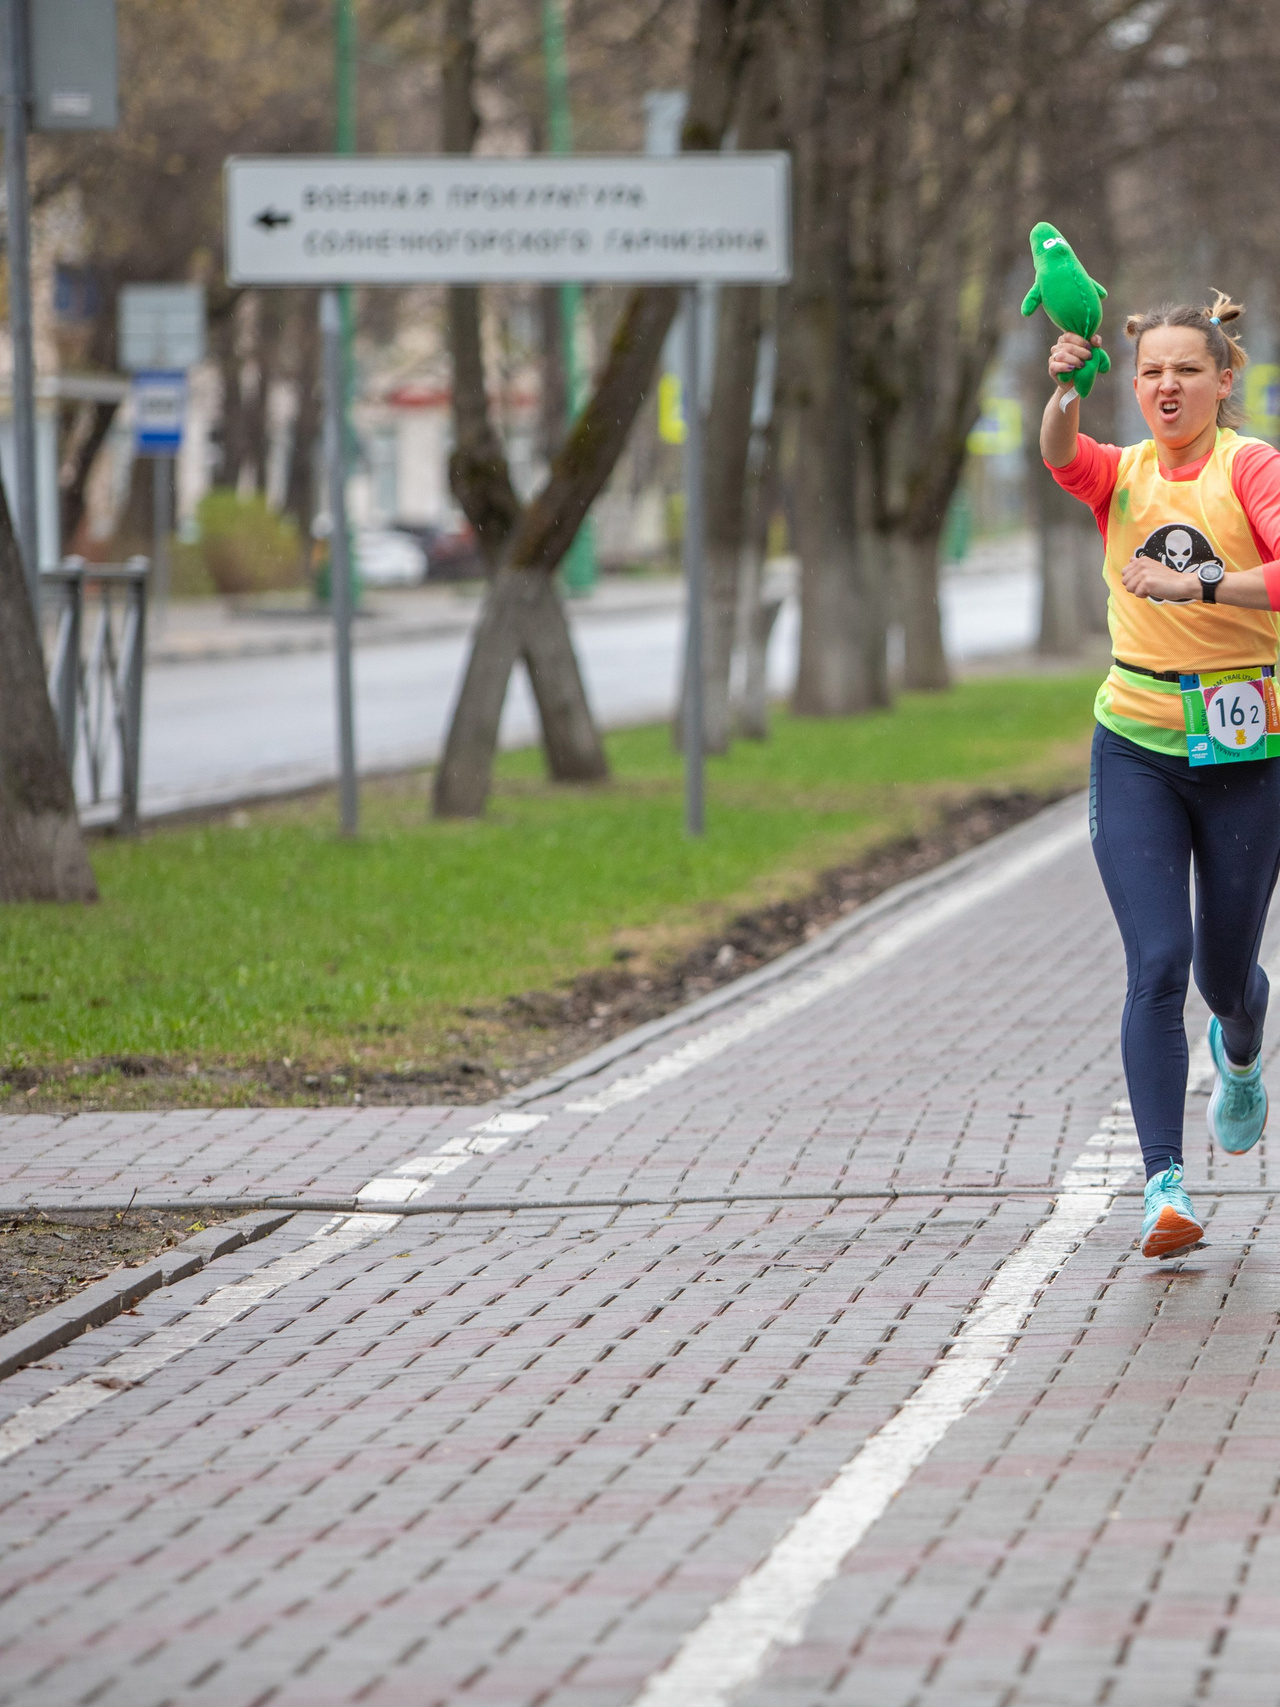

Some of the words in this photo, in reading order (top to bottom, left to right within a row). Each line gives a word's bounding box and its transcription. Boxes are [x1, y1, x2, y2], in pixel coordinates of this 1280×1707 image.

[303, 184, 434, 211] ВОЕННАЯ
[448, 183, 647, 210] ПРОКУРАТУРА
[303, 229, 592, 256] СОЛНЕЧНОГОРСКОГО
[604, 228, 768, 254] ГАРНИЗОНА
[1224, 674, 1241, 682] TRAIL
[1215, 696, 1245, 727] 16
[1250, 705, 1259, 724] 2
[1268, 686, 1278, 727] ЭСТАФЕТА
